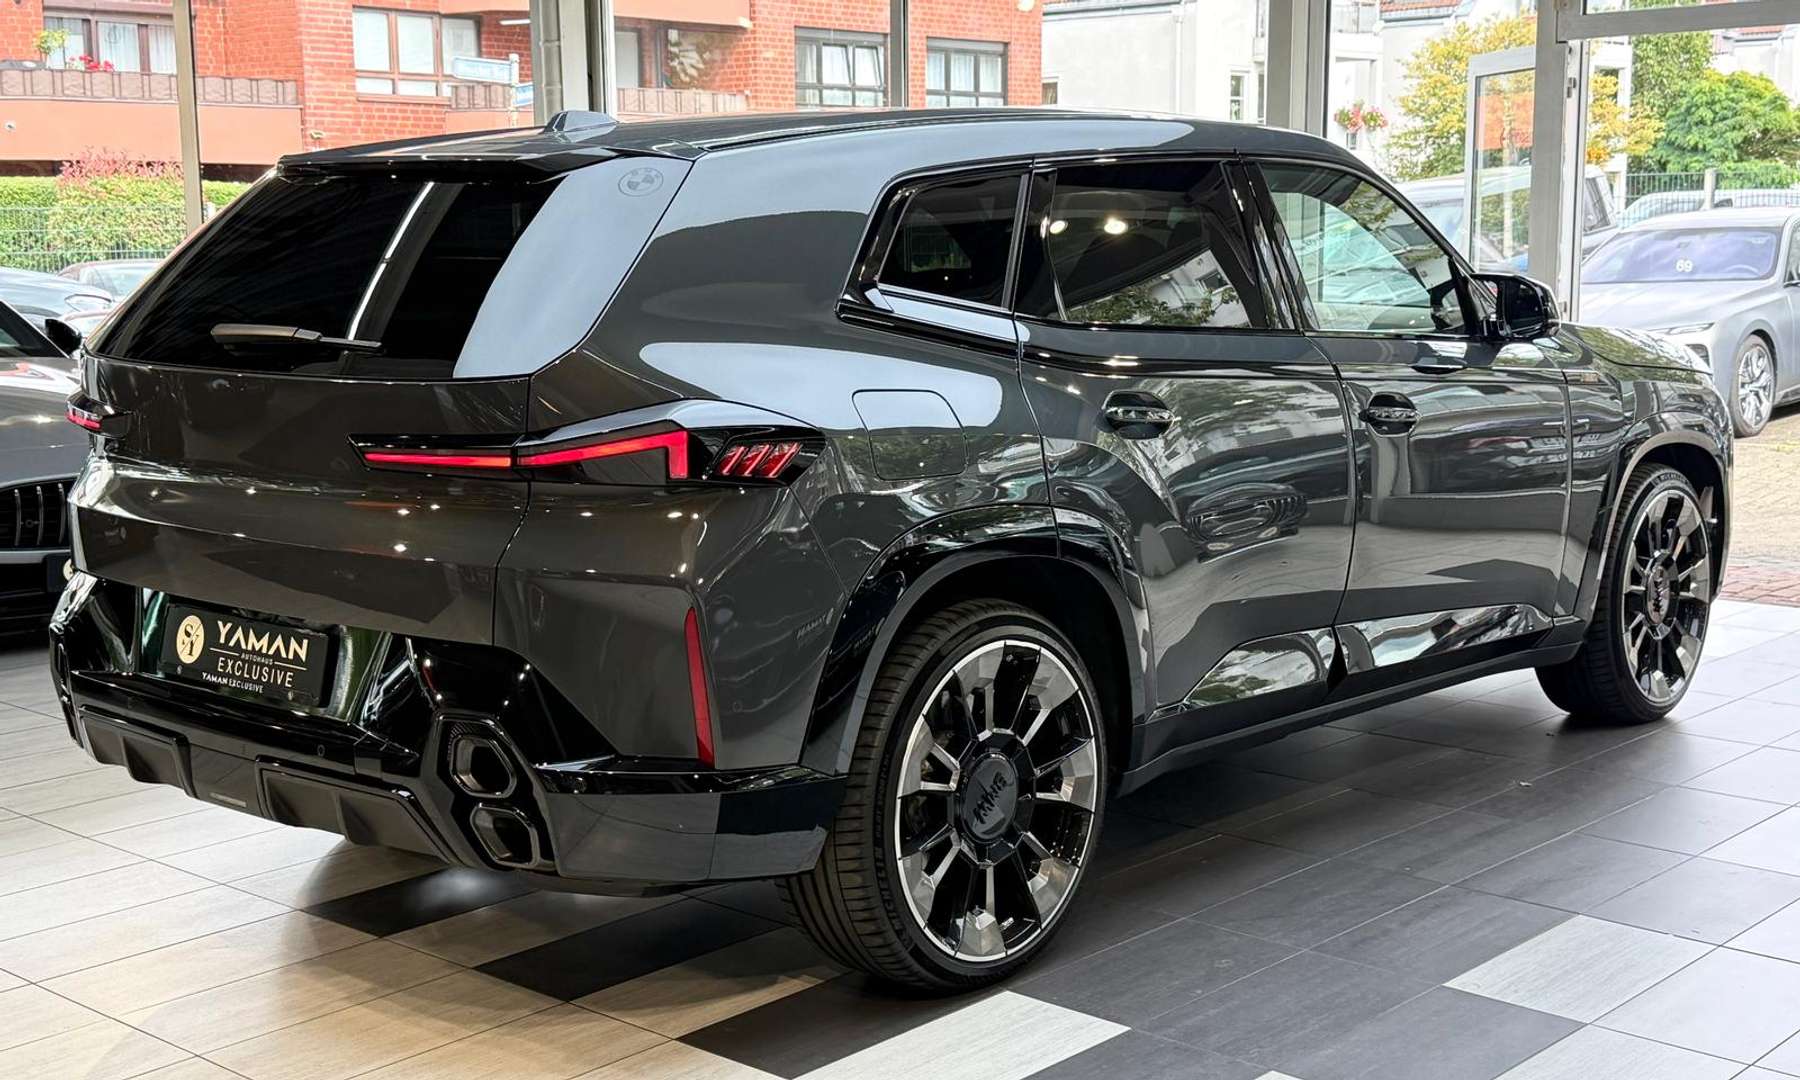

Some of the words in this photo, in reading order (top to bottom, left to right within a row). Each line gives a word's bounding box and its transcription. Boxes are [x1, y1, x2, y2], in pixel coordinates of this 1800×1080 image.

[1676, 259, 1693, 272] 69
[217, 620, 309, 662] YAMAN
[240, 652, 274, 665] AUTOHAUS
[202, 671, 228, 685] YAMAN
[228, 678, 264, 694] EXCLUSIVE
[217, 657, 294, 688] EXCLUSIVE
